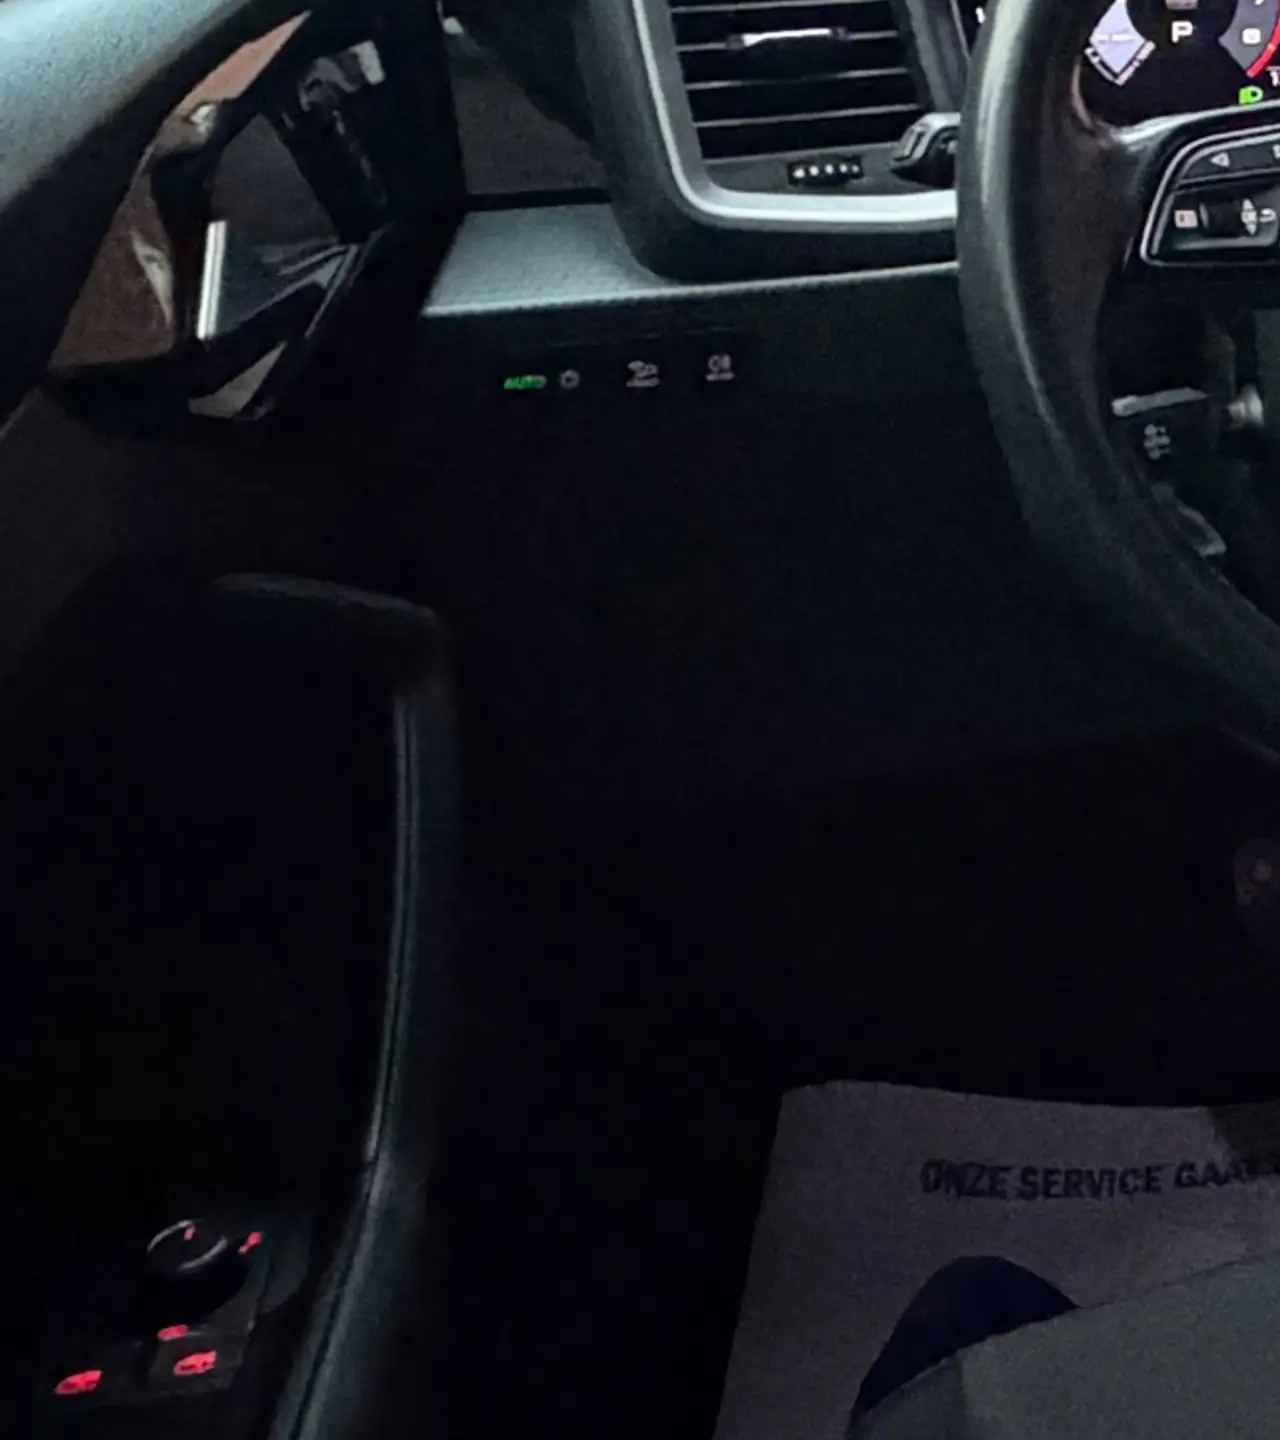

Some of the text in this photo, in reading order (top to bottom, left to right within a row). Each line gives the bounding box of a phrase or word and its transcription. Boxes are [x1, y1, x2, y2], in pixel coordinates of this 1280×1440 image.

[1171, 21, 1194, 43] P
[920, 1158, 1011, 1199] ONZE
[1017, 1165, 1162, 1201] SERVICE
